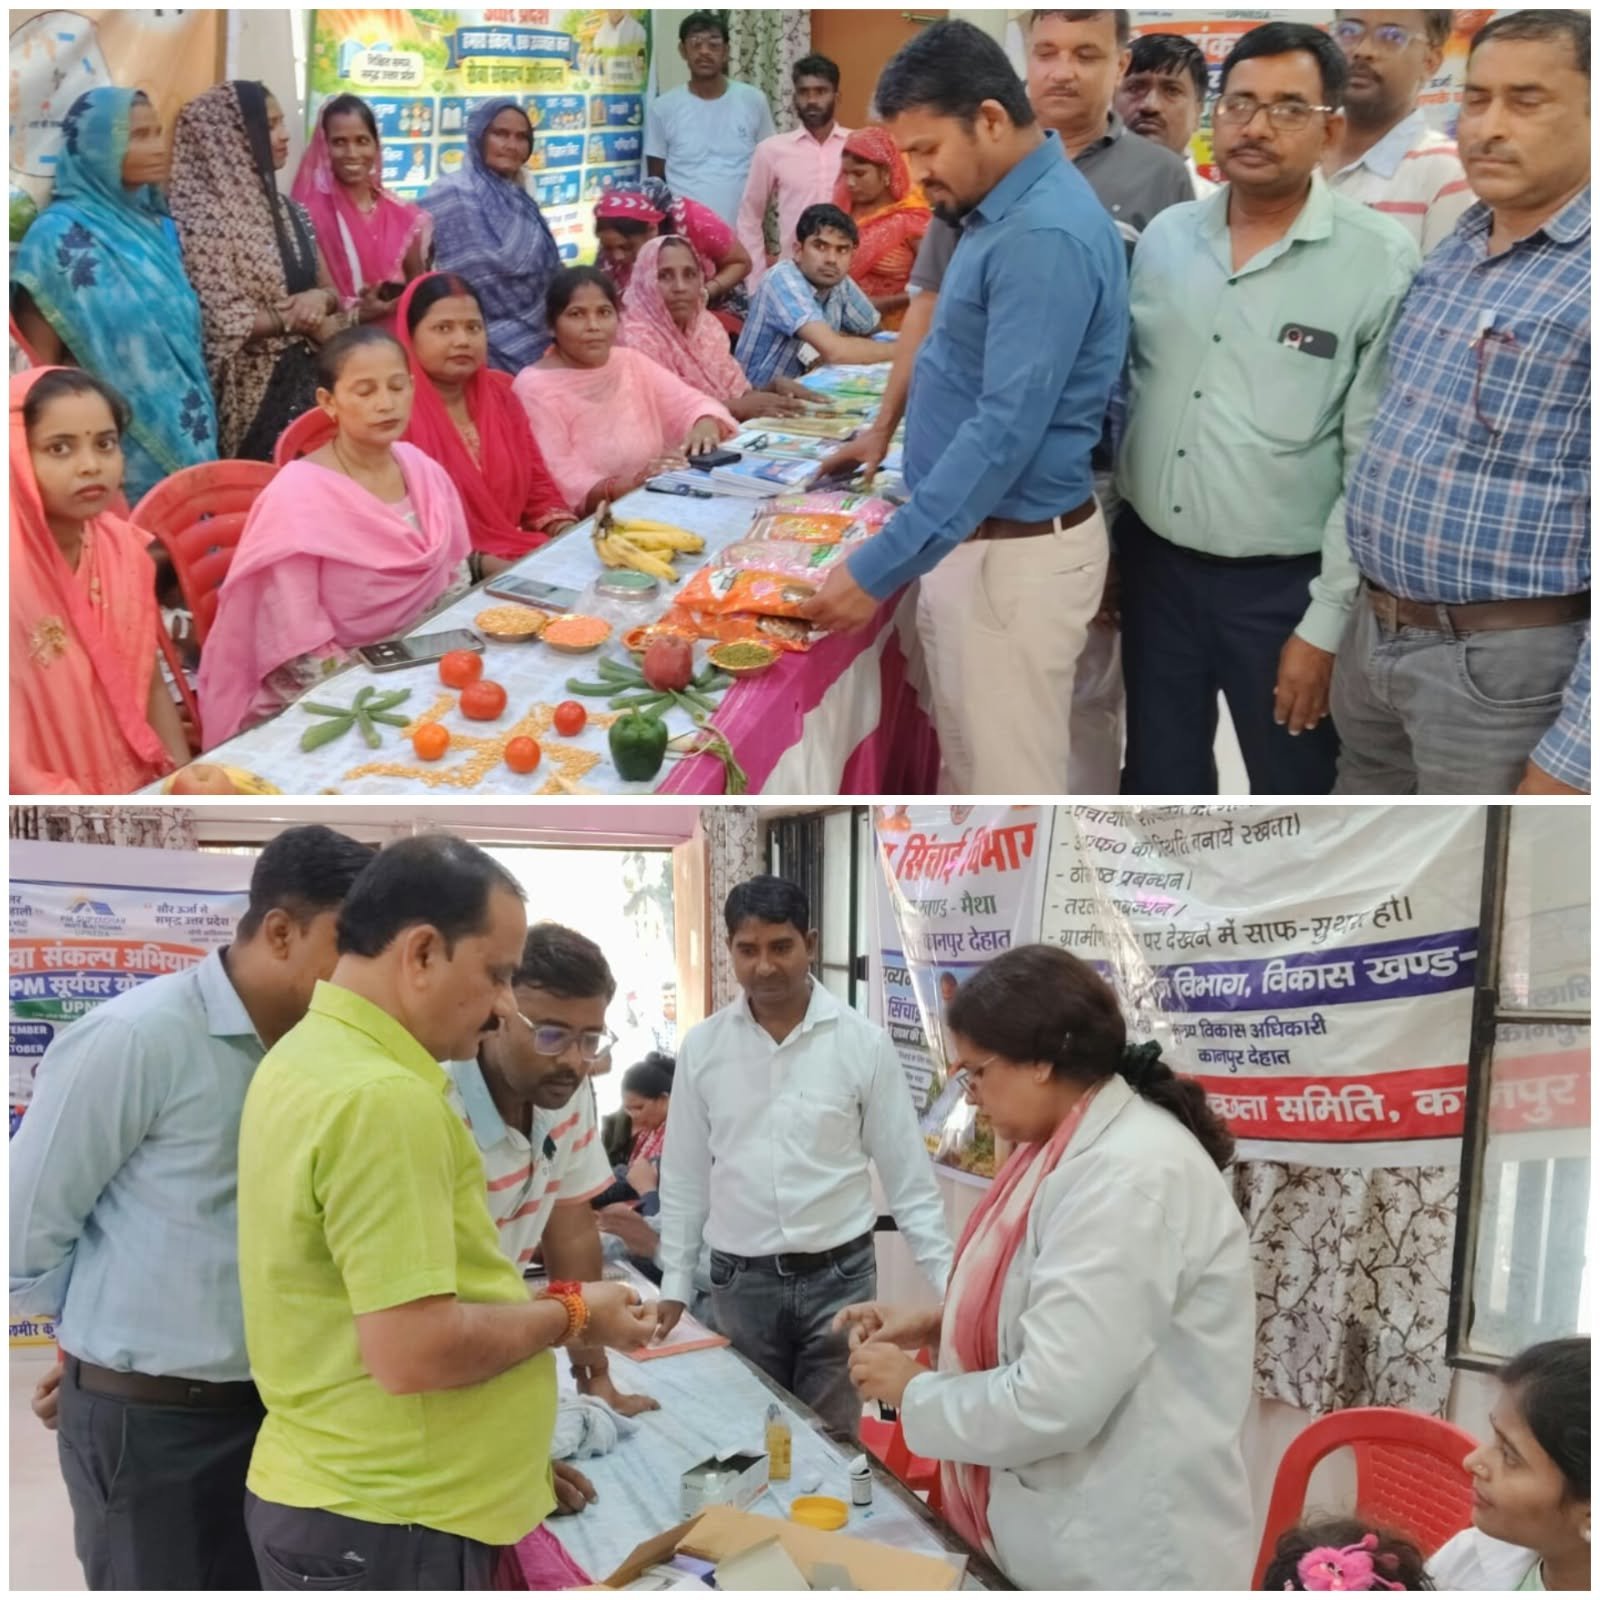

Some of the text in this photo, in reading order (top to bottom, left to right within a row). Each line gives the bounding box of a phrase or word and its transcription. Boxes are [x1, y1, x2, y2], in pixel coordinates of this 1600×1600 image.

[969, 926, 1012, 951] देहात
[1217, 917, 1236, 945] में
[42, 940, 119, 969] संकल्प
[9, 977, 46, 997] PM
[48, 971, 113, 998] सूर्यघर
[1173, 966, 1252, 999] विभाग,
[1261, 959, 1356, 996] विकास
[10, 1025, 48, 1035] EMBER
[1199, 1018, 1247, 1039] विकास
[1249, 1012, 1327, 1040] अधिकारी
[9, 1044, 44, 1054] TOBER
[1198, 1045, 1291, 1073] कानपुर देहात
[1206, 1092, 1269, 1123] च्छता
[1275, 1083, 1400, 1125] समिति,
[42, 1322, 56, 1340] कु
